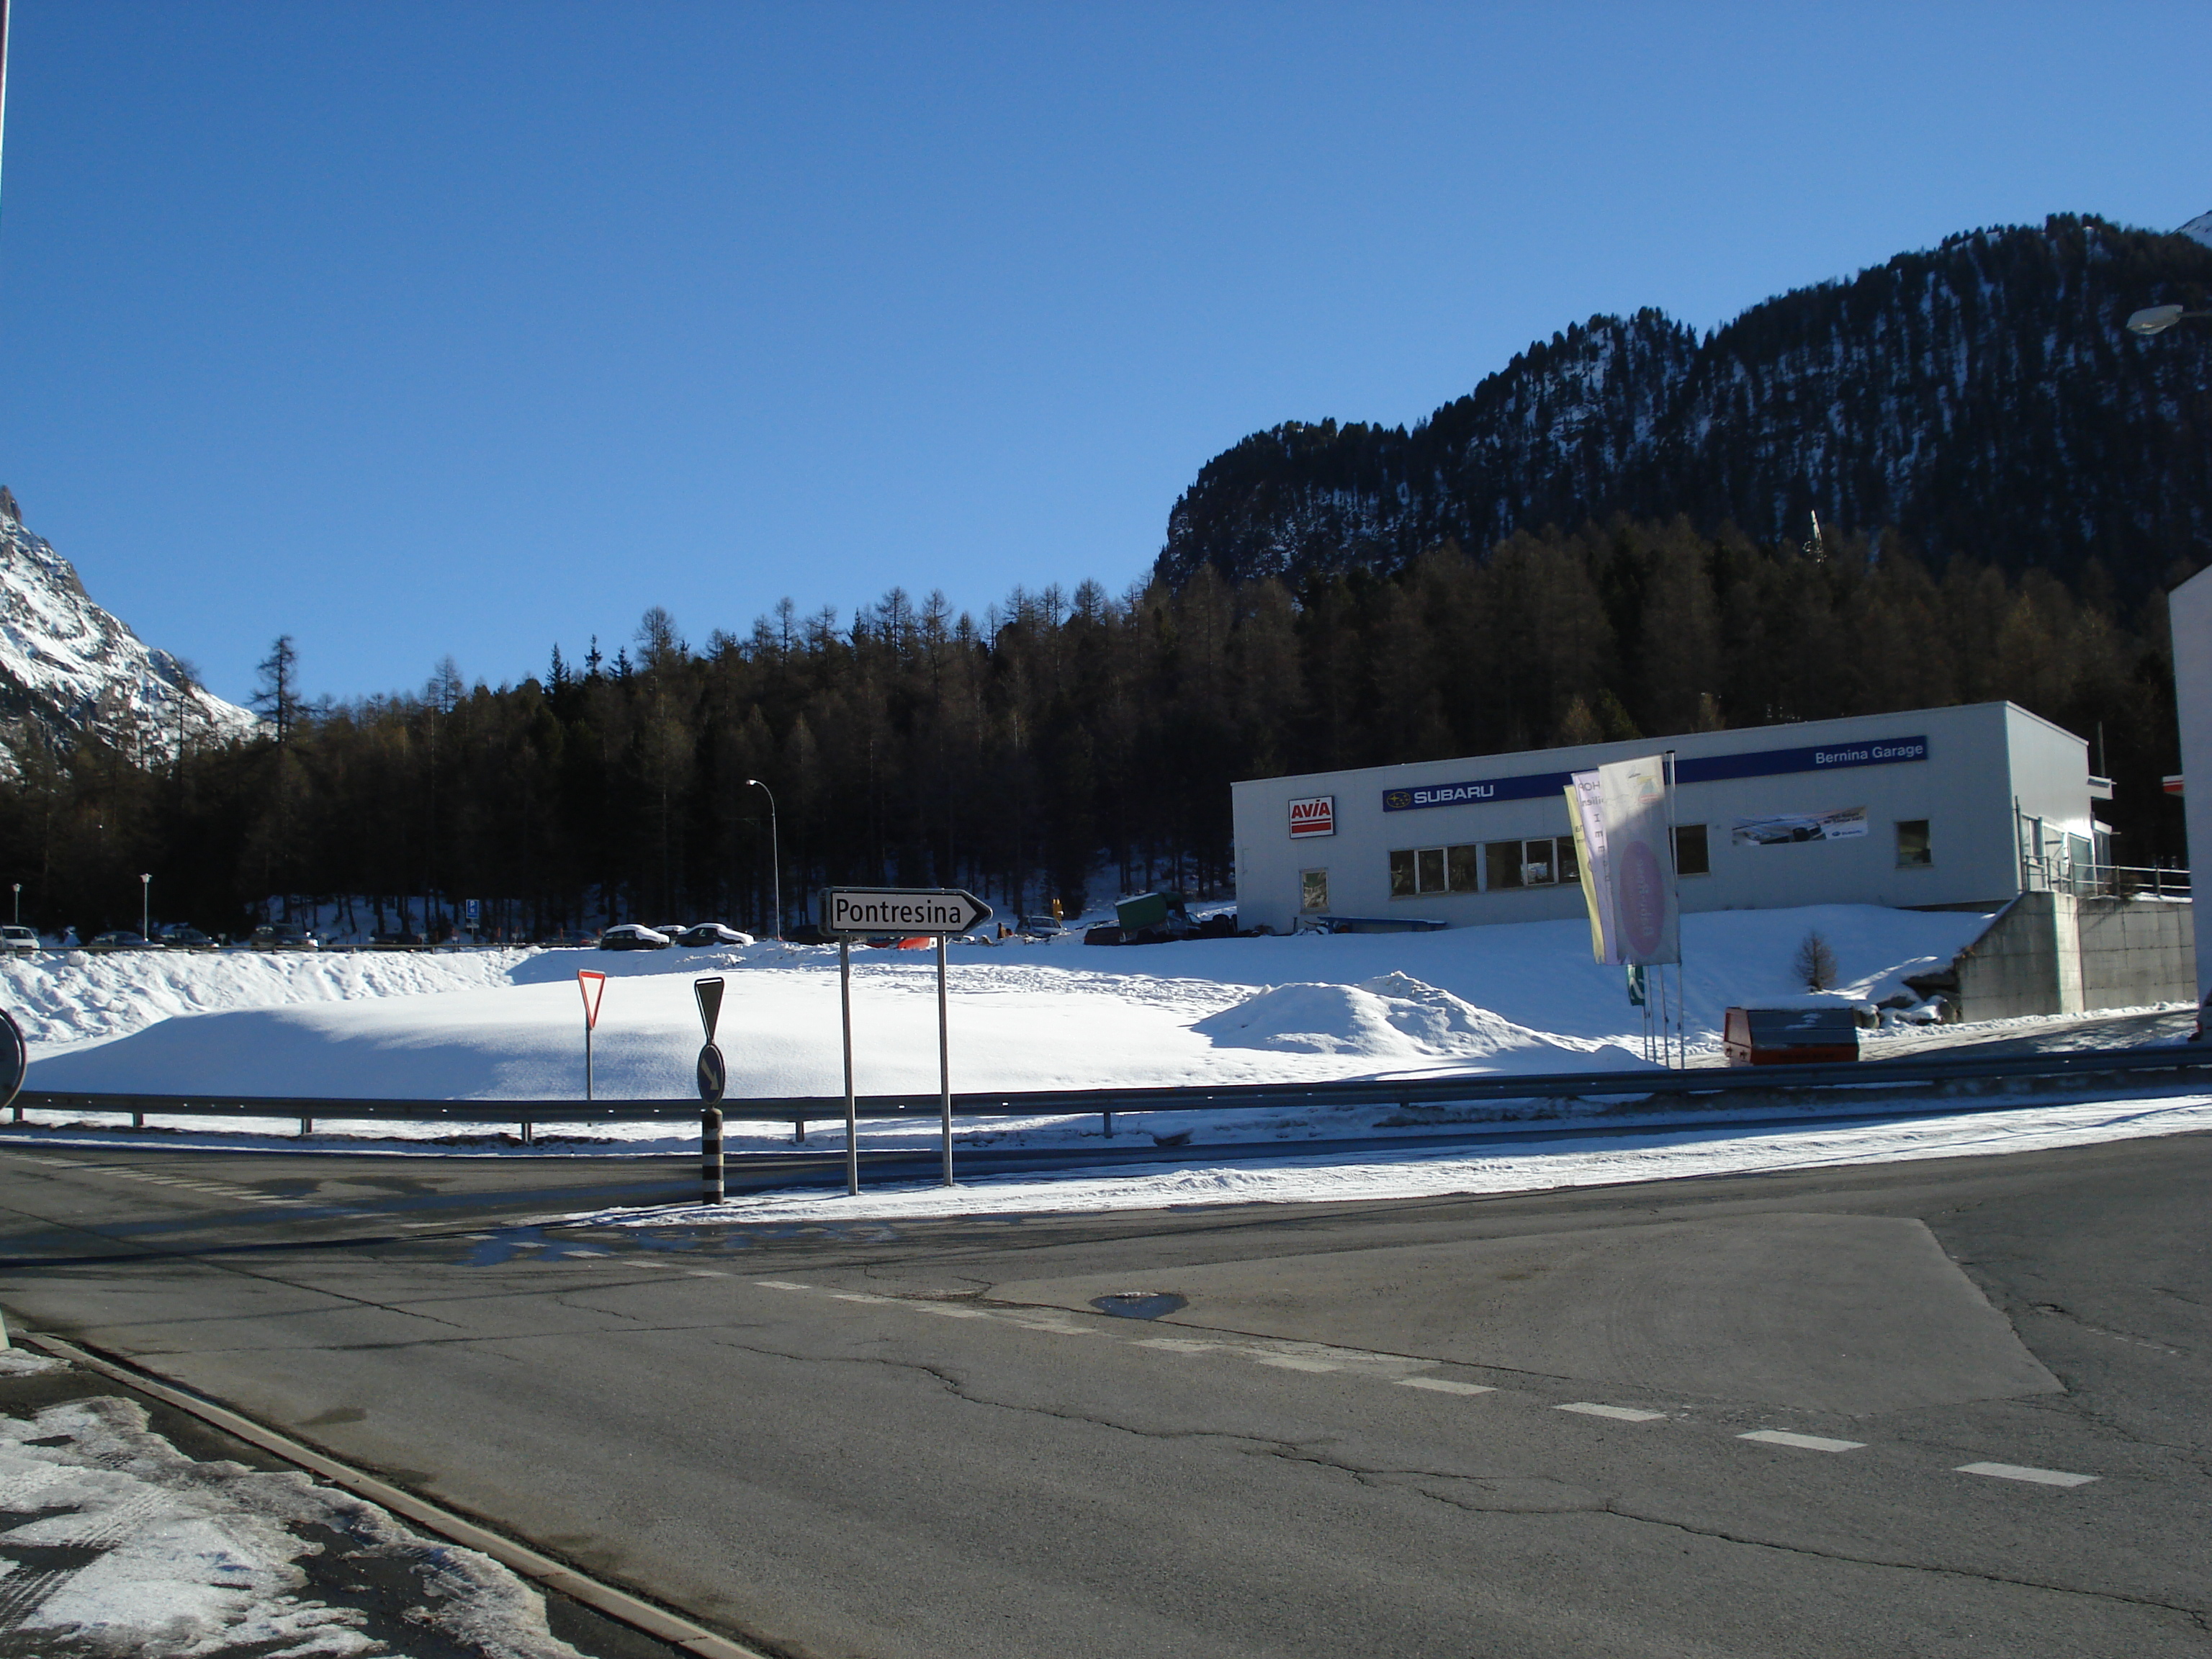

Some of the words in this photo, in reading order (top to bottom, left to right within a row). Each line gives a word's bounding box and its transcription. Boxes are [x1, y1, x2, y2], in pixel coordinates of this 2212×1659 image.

[1815, 750, 1868, 764] Bernina
[1873, 745, 1923, 757] Garage
[1414, 785, 1494, 804] SUBARU
[836, 899, 961, 923] Pontresina
